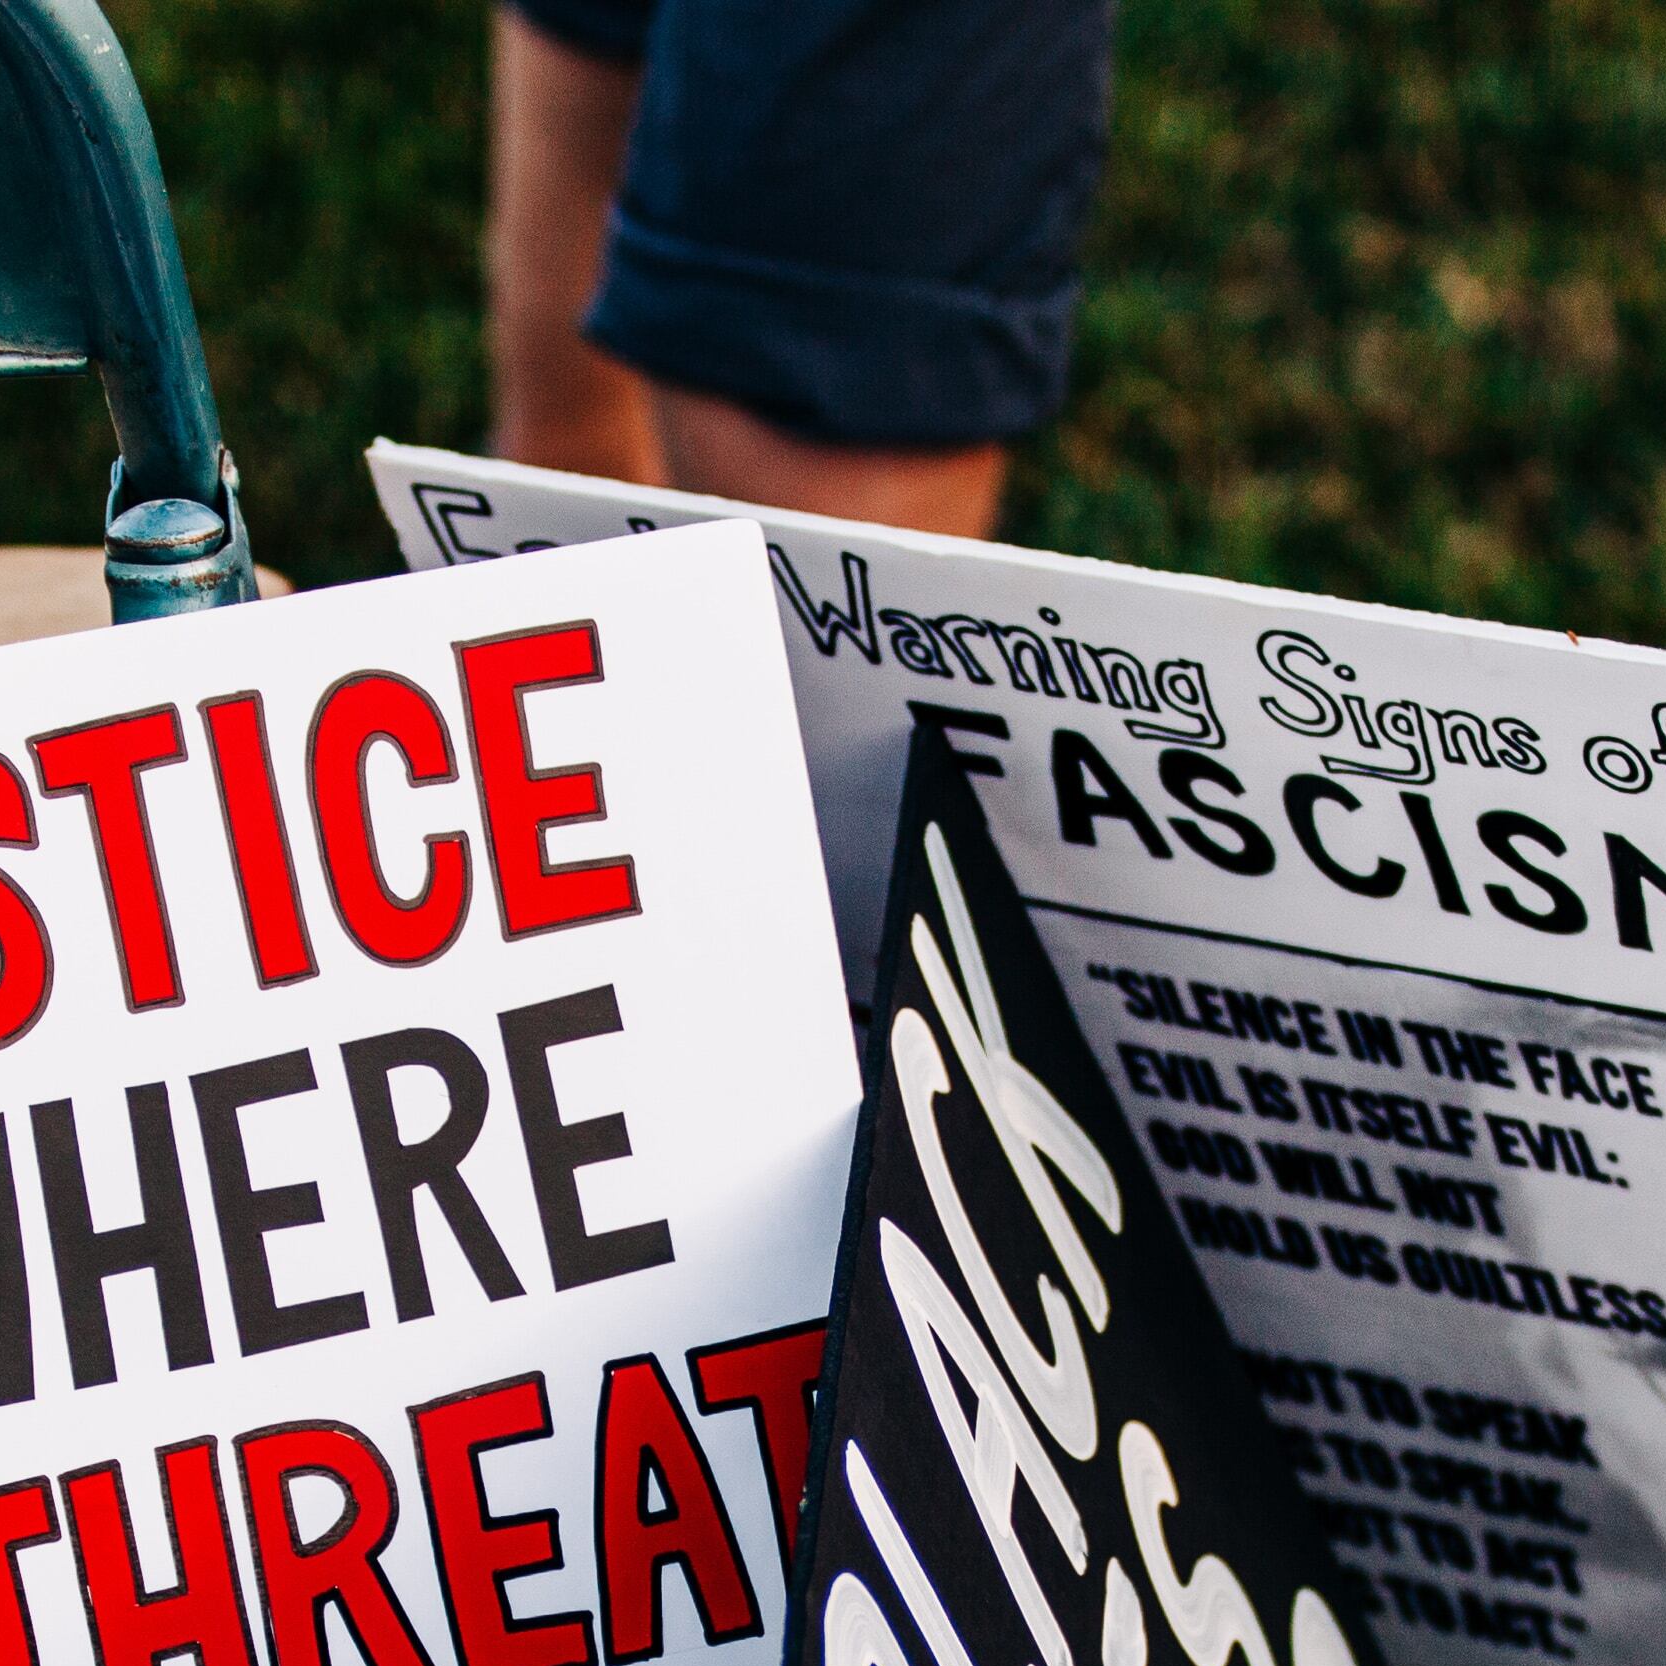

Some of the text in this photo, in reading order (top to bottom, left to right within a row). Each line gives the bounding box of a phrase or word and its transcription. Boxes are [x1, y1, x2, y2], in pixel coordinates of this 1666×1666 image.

[765, 542, 1226, 749] Warning
[1257, 630, 1548, 785] Signs
[1117, 1042, 1630, 1188] EVIL IS ITSELF EVIL:
[1336, 1009, 1403, 1068] IN
[1401, 1019, 1517, 1090] THE
[1518, 1041, 1663, 1118] FACE
[1147, 1117, 1505, 1237] GOD WILL NOT
[1175, 1195, 1321, 1271] HOLD
[1319, 1223, 1400, 1286] US
[1323, 1431, 1400, 1491] TO
[1344, 1368, 1423, 1431] TO
[1423, 1385, 1601, 1470] SPEAK
[1398, 1512, 1477, 1573] TO
[1483, 1529, 1583, 1596] ACT
